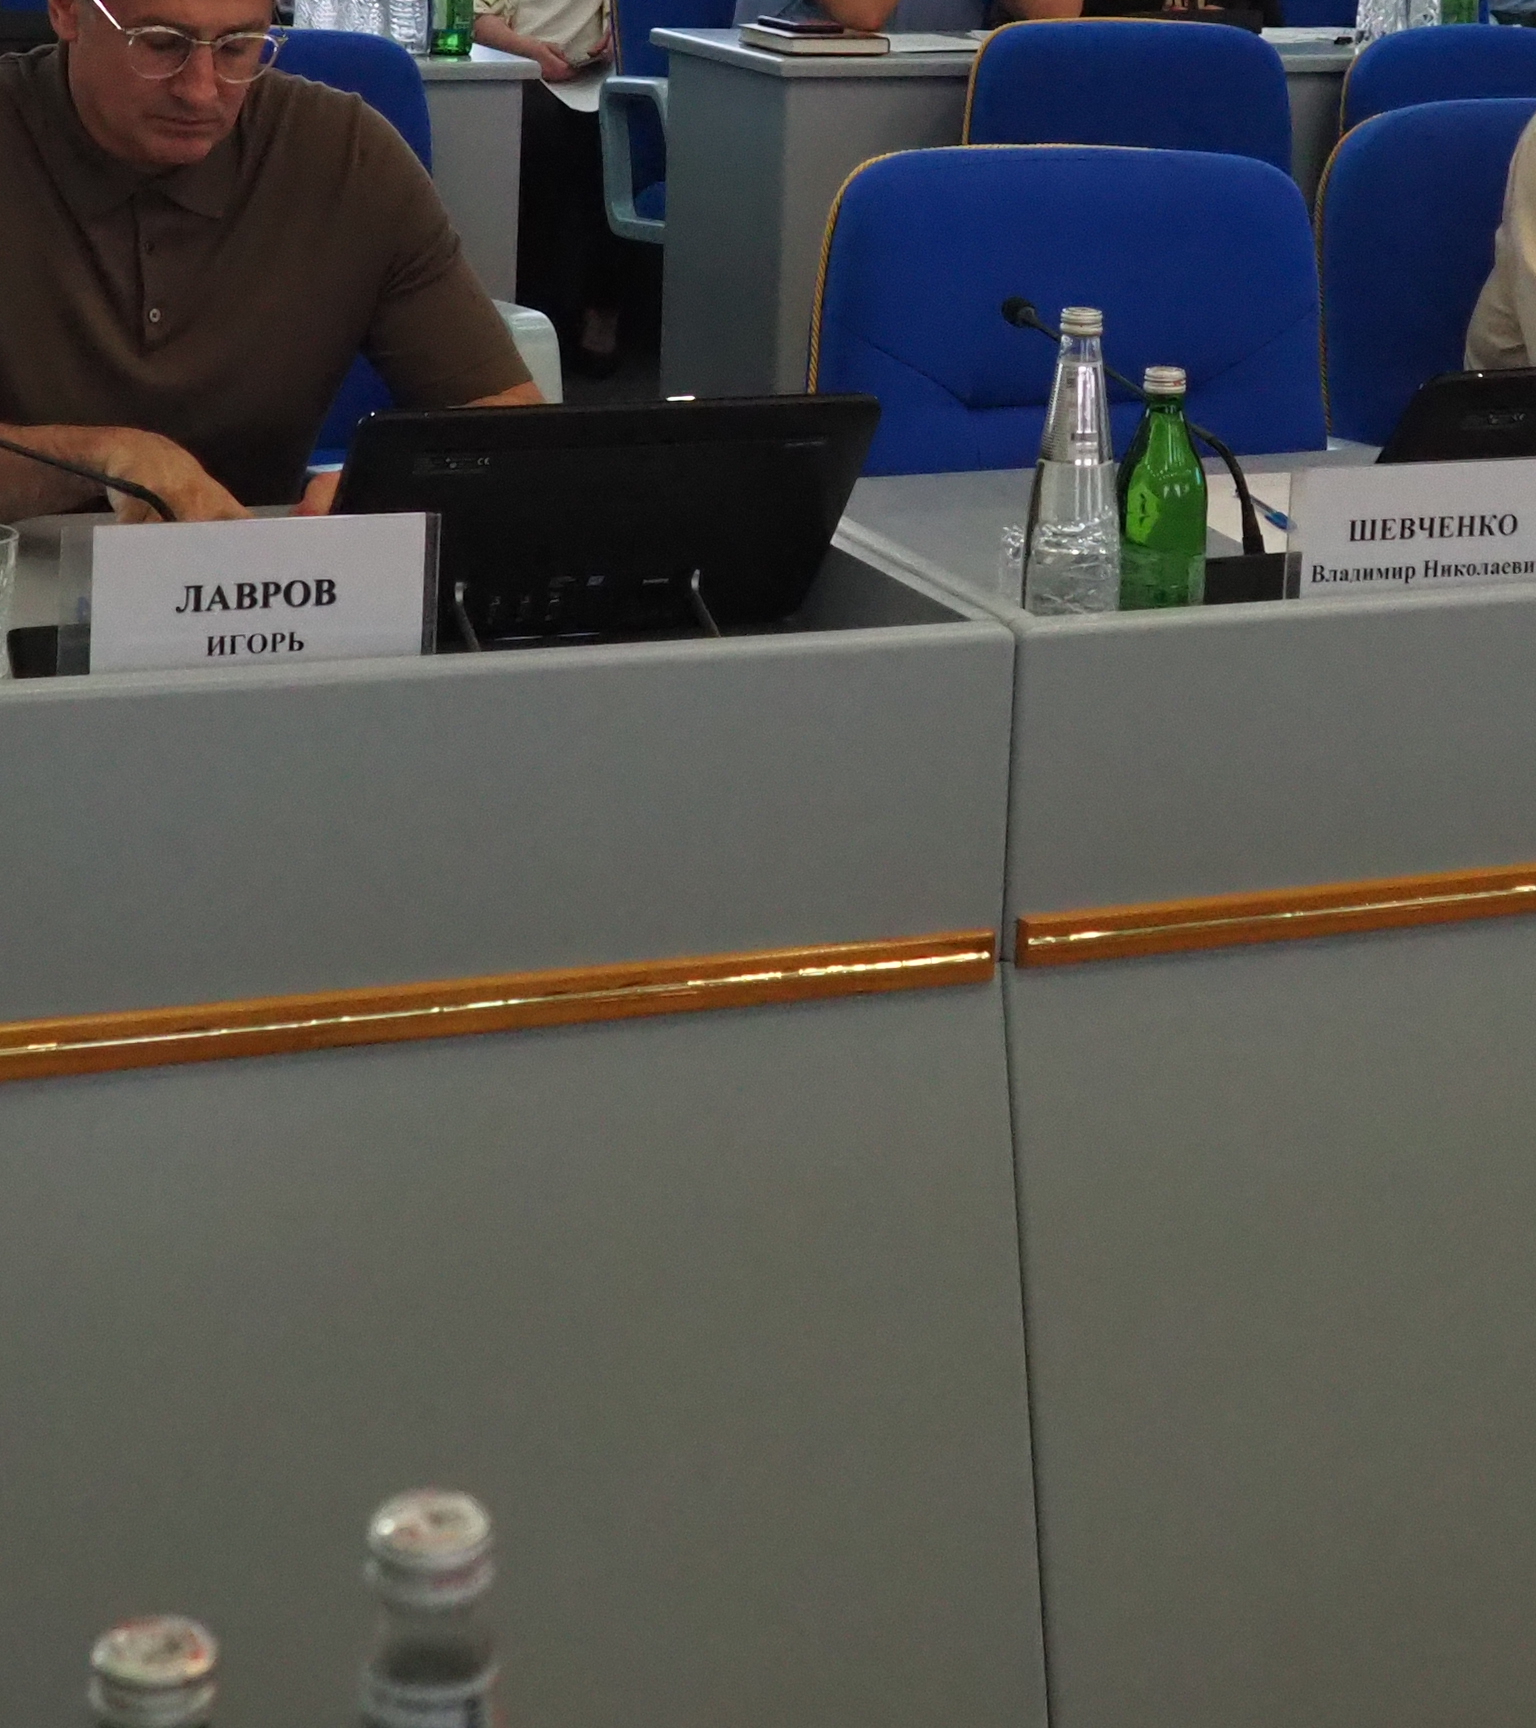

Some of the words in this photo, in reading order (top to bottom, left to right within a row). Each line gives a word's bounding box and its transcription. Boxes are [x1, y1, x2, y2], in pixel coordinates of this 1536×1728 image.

[1348, 513, 1519, 542] ШЕВЧЕНКО
[1311, 564, 1416, 584] Владимир
[175, 578, 338, 613] ЛАВРОВ
[206, 631, 305, 657] ИГОРЬ
